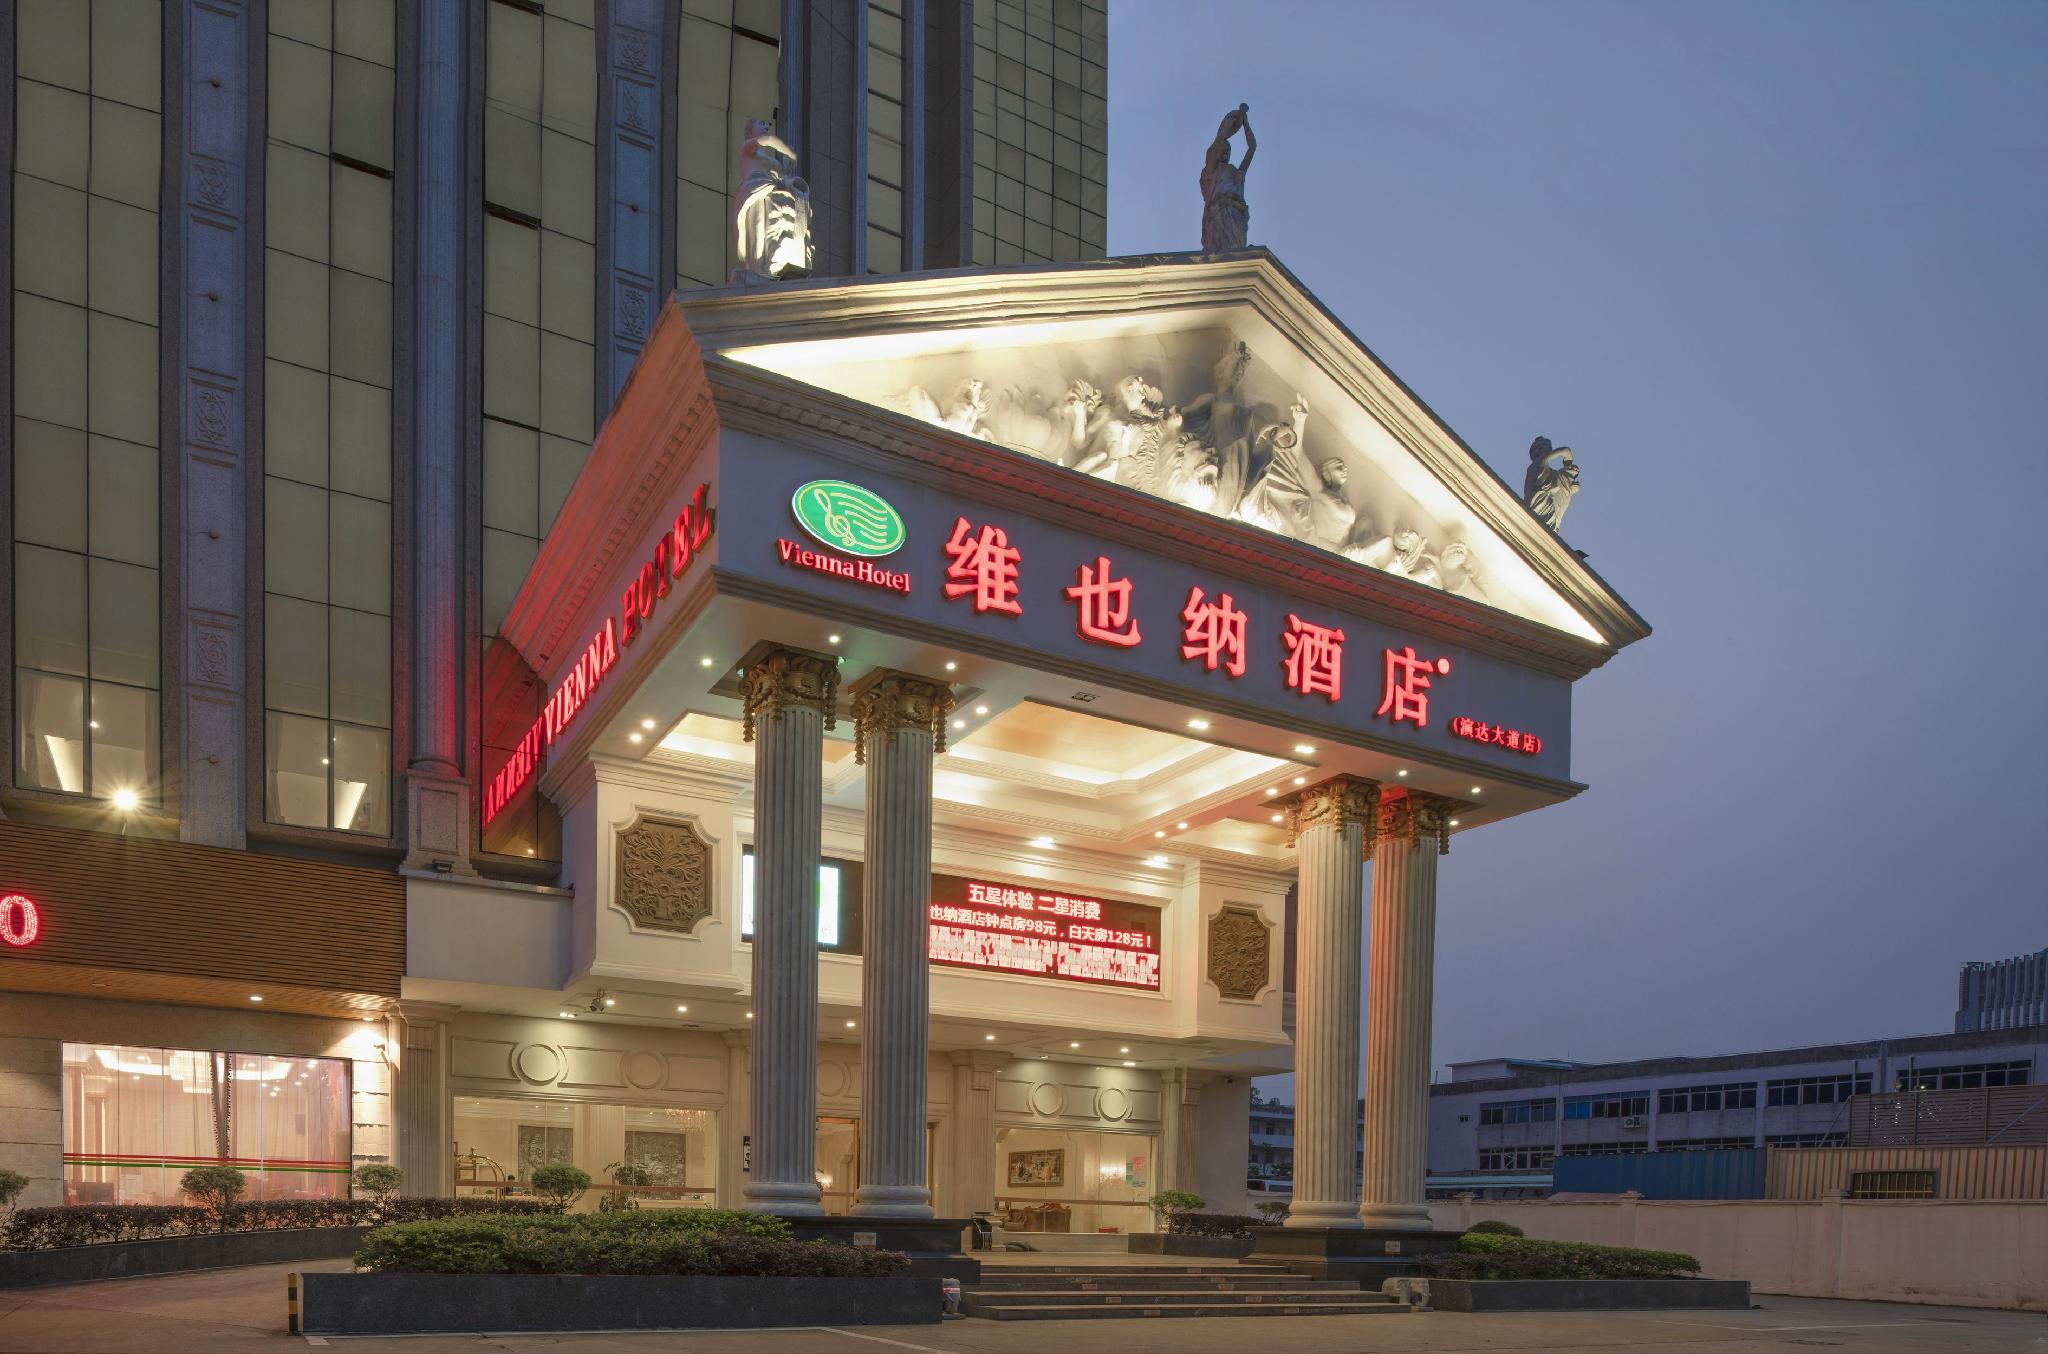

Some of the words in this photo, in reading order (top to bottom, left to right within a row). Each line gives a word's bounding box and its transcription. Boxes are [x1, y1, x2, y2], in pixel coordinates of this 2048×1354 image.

[544, 616, 617, 745] VIENNA
[622, 483, 714, 648] HOTEL
[778, 538, 855, 578] Vienna
[857, 560, 911, 592] Hotel
[944, 516, 1434, 728] 维也纳酒店
[968, 883, 1034, 910] 五星体验
[1038, 895, 1101, 920] 二星消费
